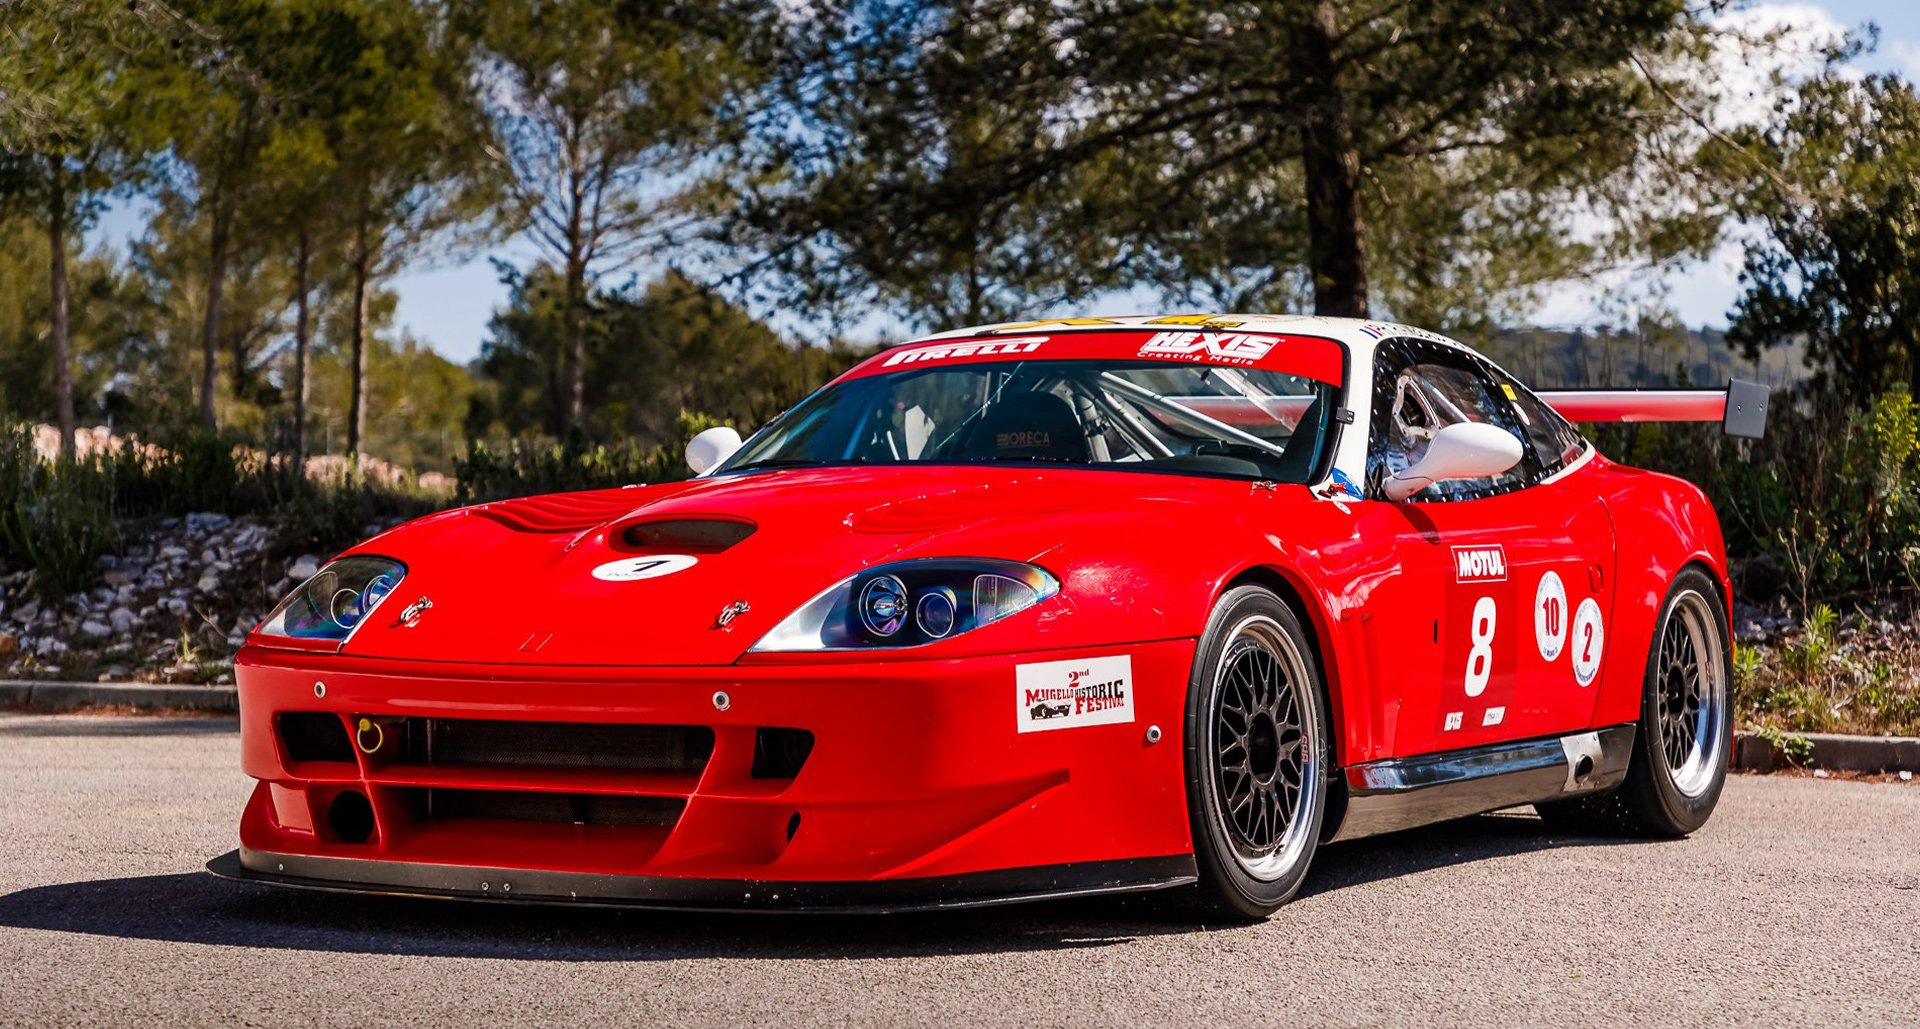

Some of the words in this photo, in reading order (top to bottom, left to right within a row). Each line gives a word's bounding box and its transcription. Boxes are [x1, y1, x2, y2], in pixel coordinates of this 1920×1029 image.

[882, 336, 1050, 368] PIRELLI
[1137, 351, 1203, 362] Creating
[1209, 355, 1254, 366] Media
[1140, 331, 1280, 360] HEXIS
[1008, 432, 1050, 446] ORECA
[1458, 550, 1505, 578] MOTUL
[1542, 597, 1560, 637] 10
[1464, 596, 1497, 698] 8
[1582, 621, 1593, 663] 2
[1068, 668, 1090, 688] 2nd
[1025, 688, 1074, 707] MUGELLO
[1074, 679, 1125, 701] HISTORIC
[1074, 697, 1125, 715] FESTIVAL
